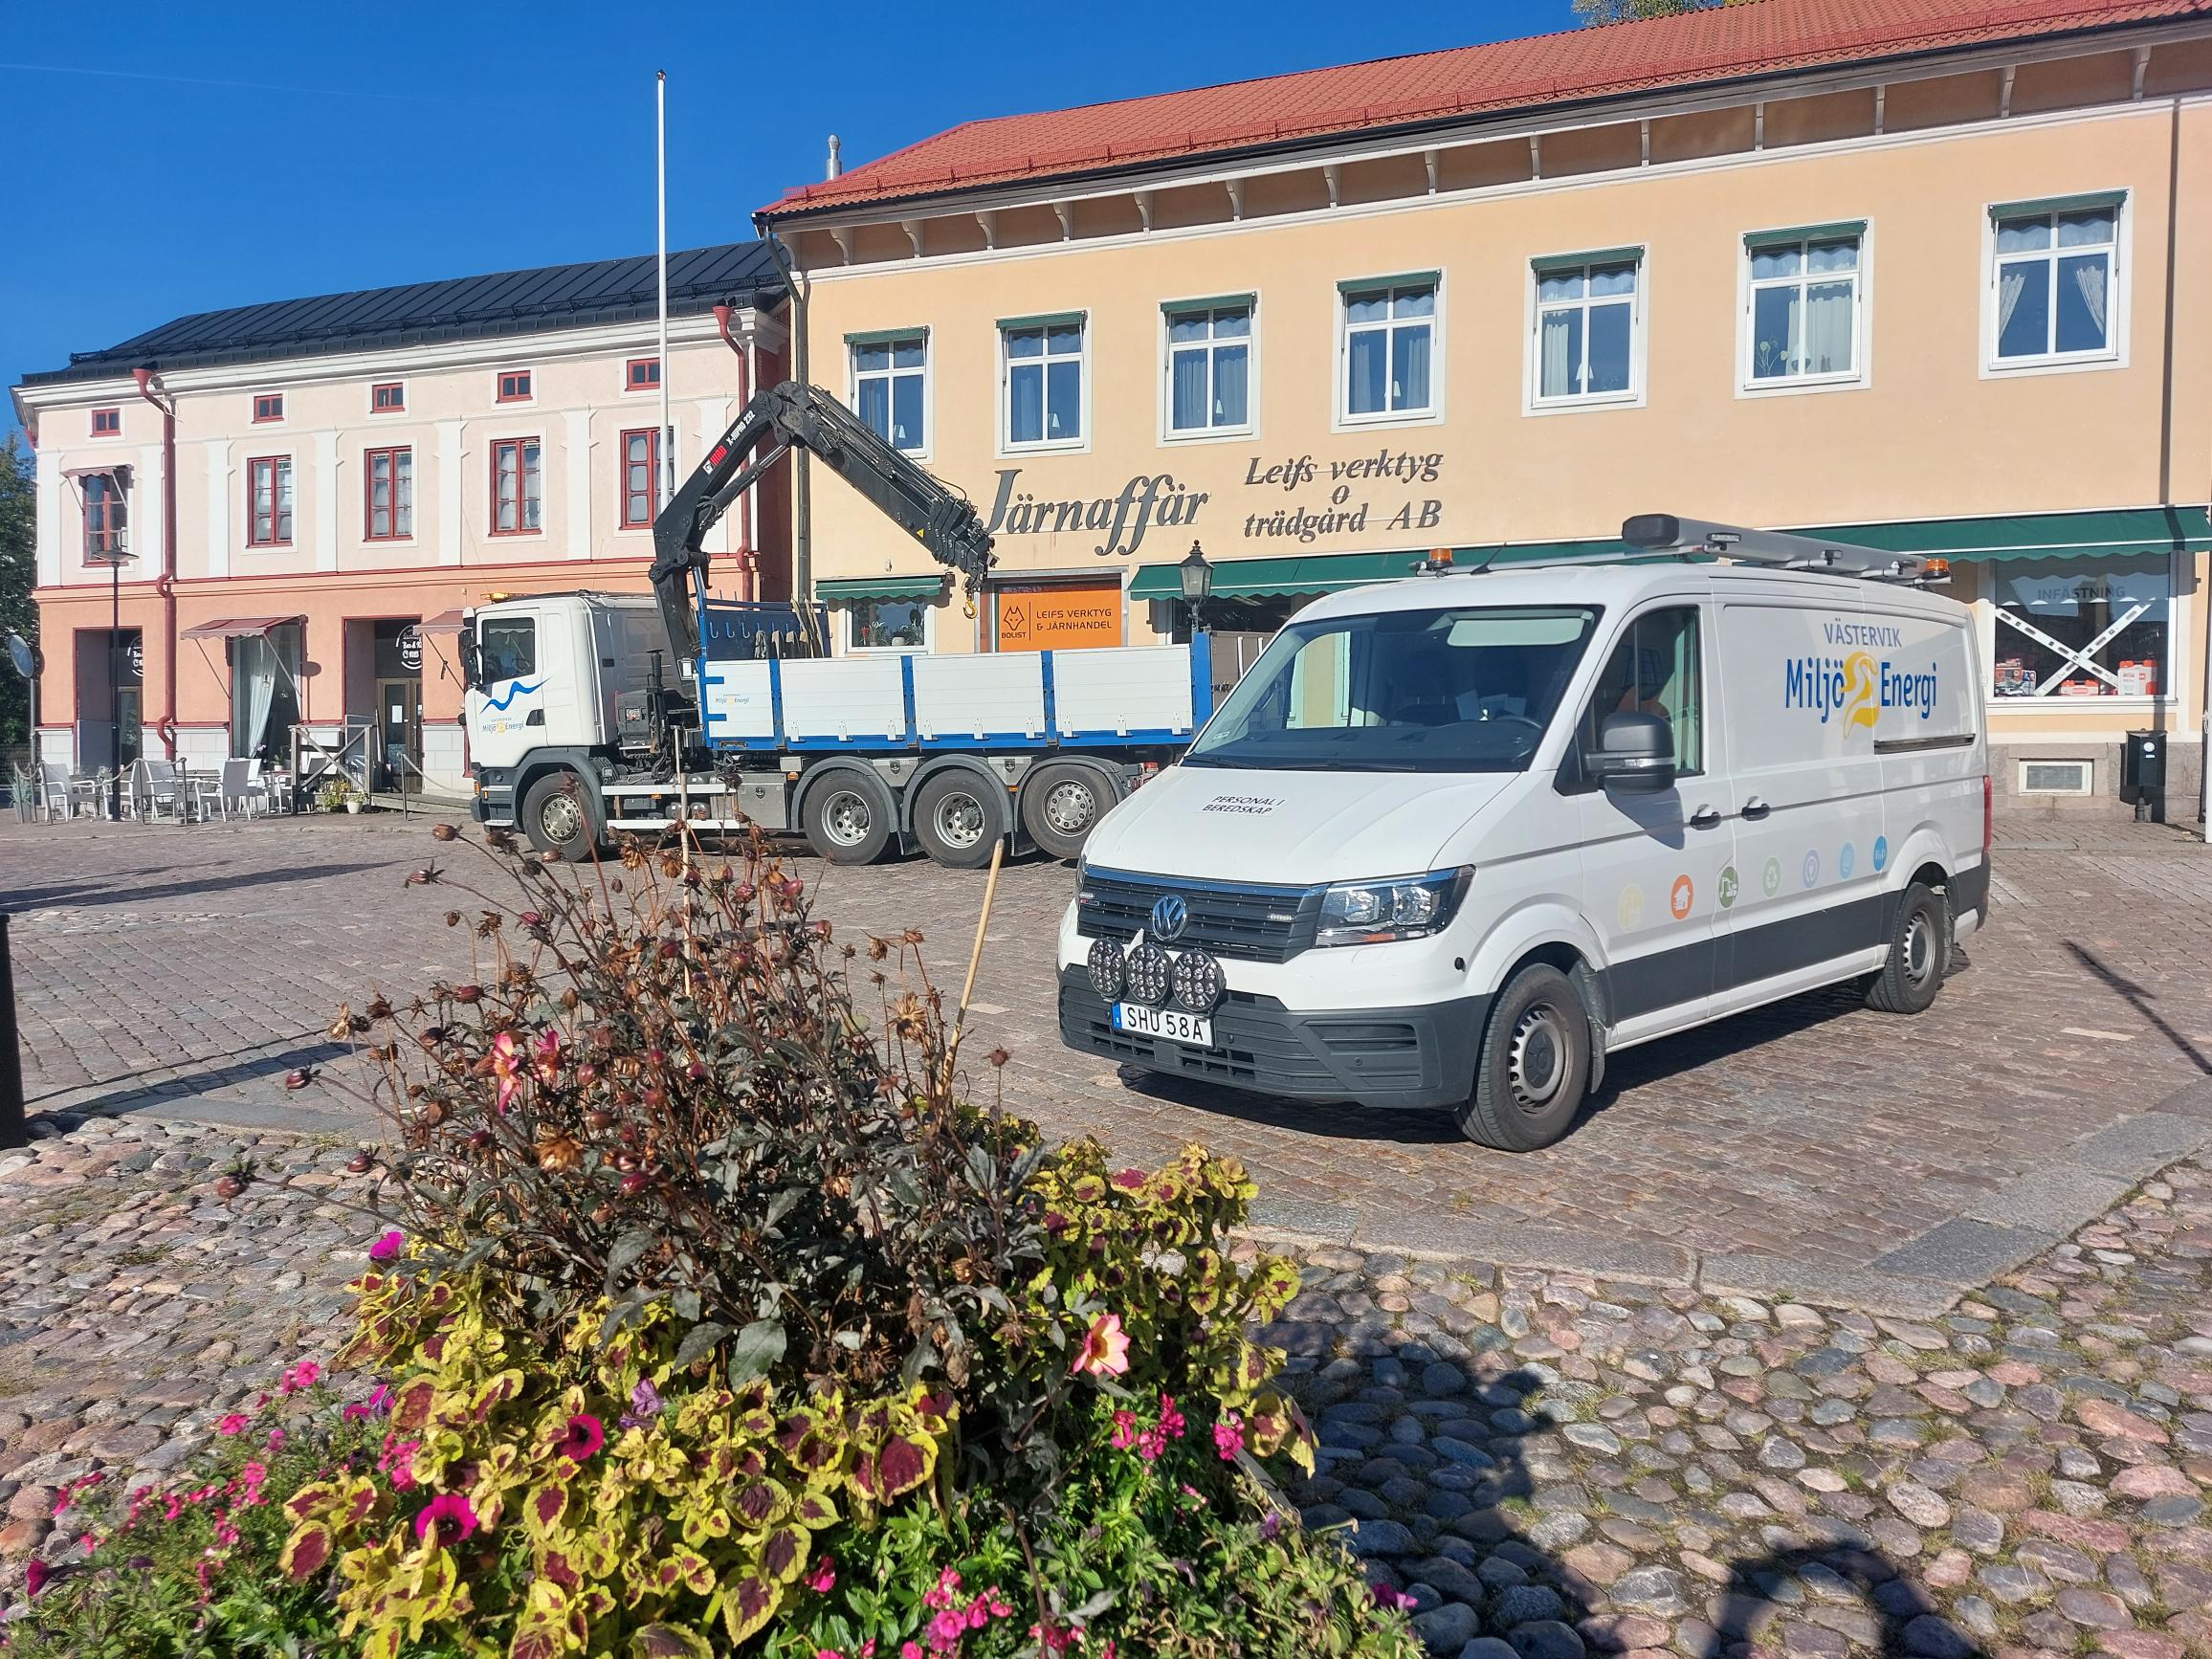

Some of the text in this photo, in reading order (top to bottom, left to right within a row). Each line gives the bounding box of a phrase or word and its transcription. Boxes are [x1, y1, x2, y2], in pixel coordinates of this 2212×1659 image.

[743, 409, 756, 426] 232
[1245, 449, 1444, 491] Leifs verktyg
[987, 468, 1209, 557] Järnaffär
[1244, 499, 1443, 543] trädgård AB
[2038, 586, 2125, 600] INFÄSTNING
[1036, 608, 1112, 619] LEIFS VERKTYG
[1047, 621, 1113, 630] JÄRNHANDEL
[1824, 617, 1902, 648] VÄSTERVIK
[1786, 656, 1937, 724] Miljö Energi
[505, 720, 524, 731] Energi
[1211, 795, 1276, 805] PERSONAL
[1202, 804, 1272, 814] BEREDSKAP
[1127, 1007, 1204, 1041] SHU 58A
